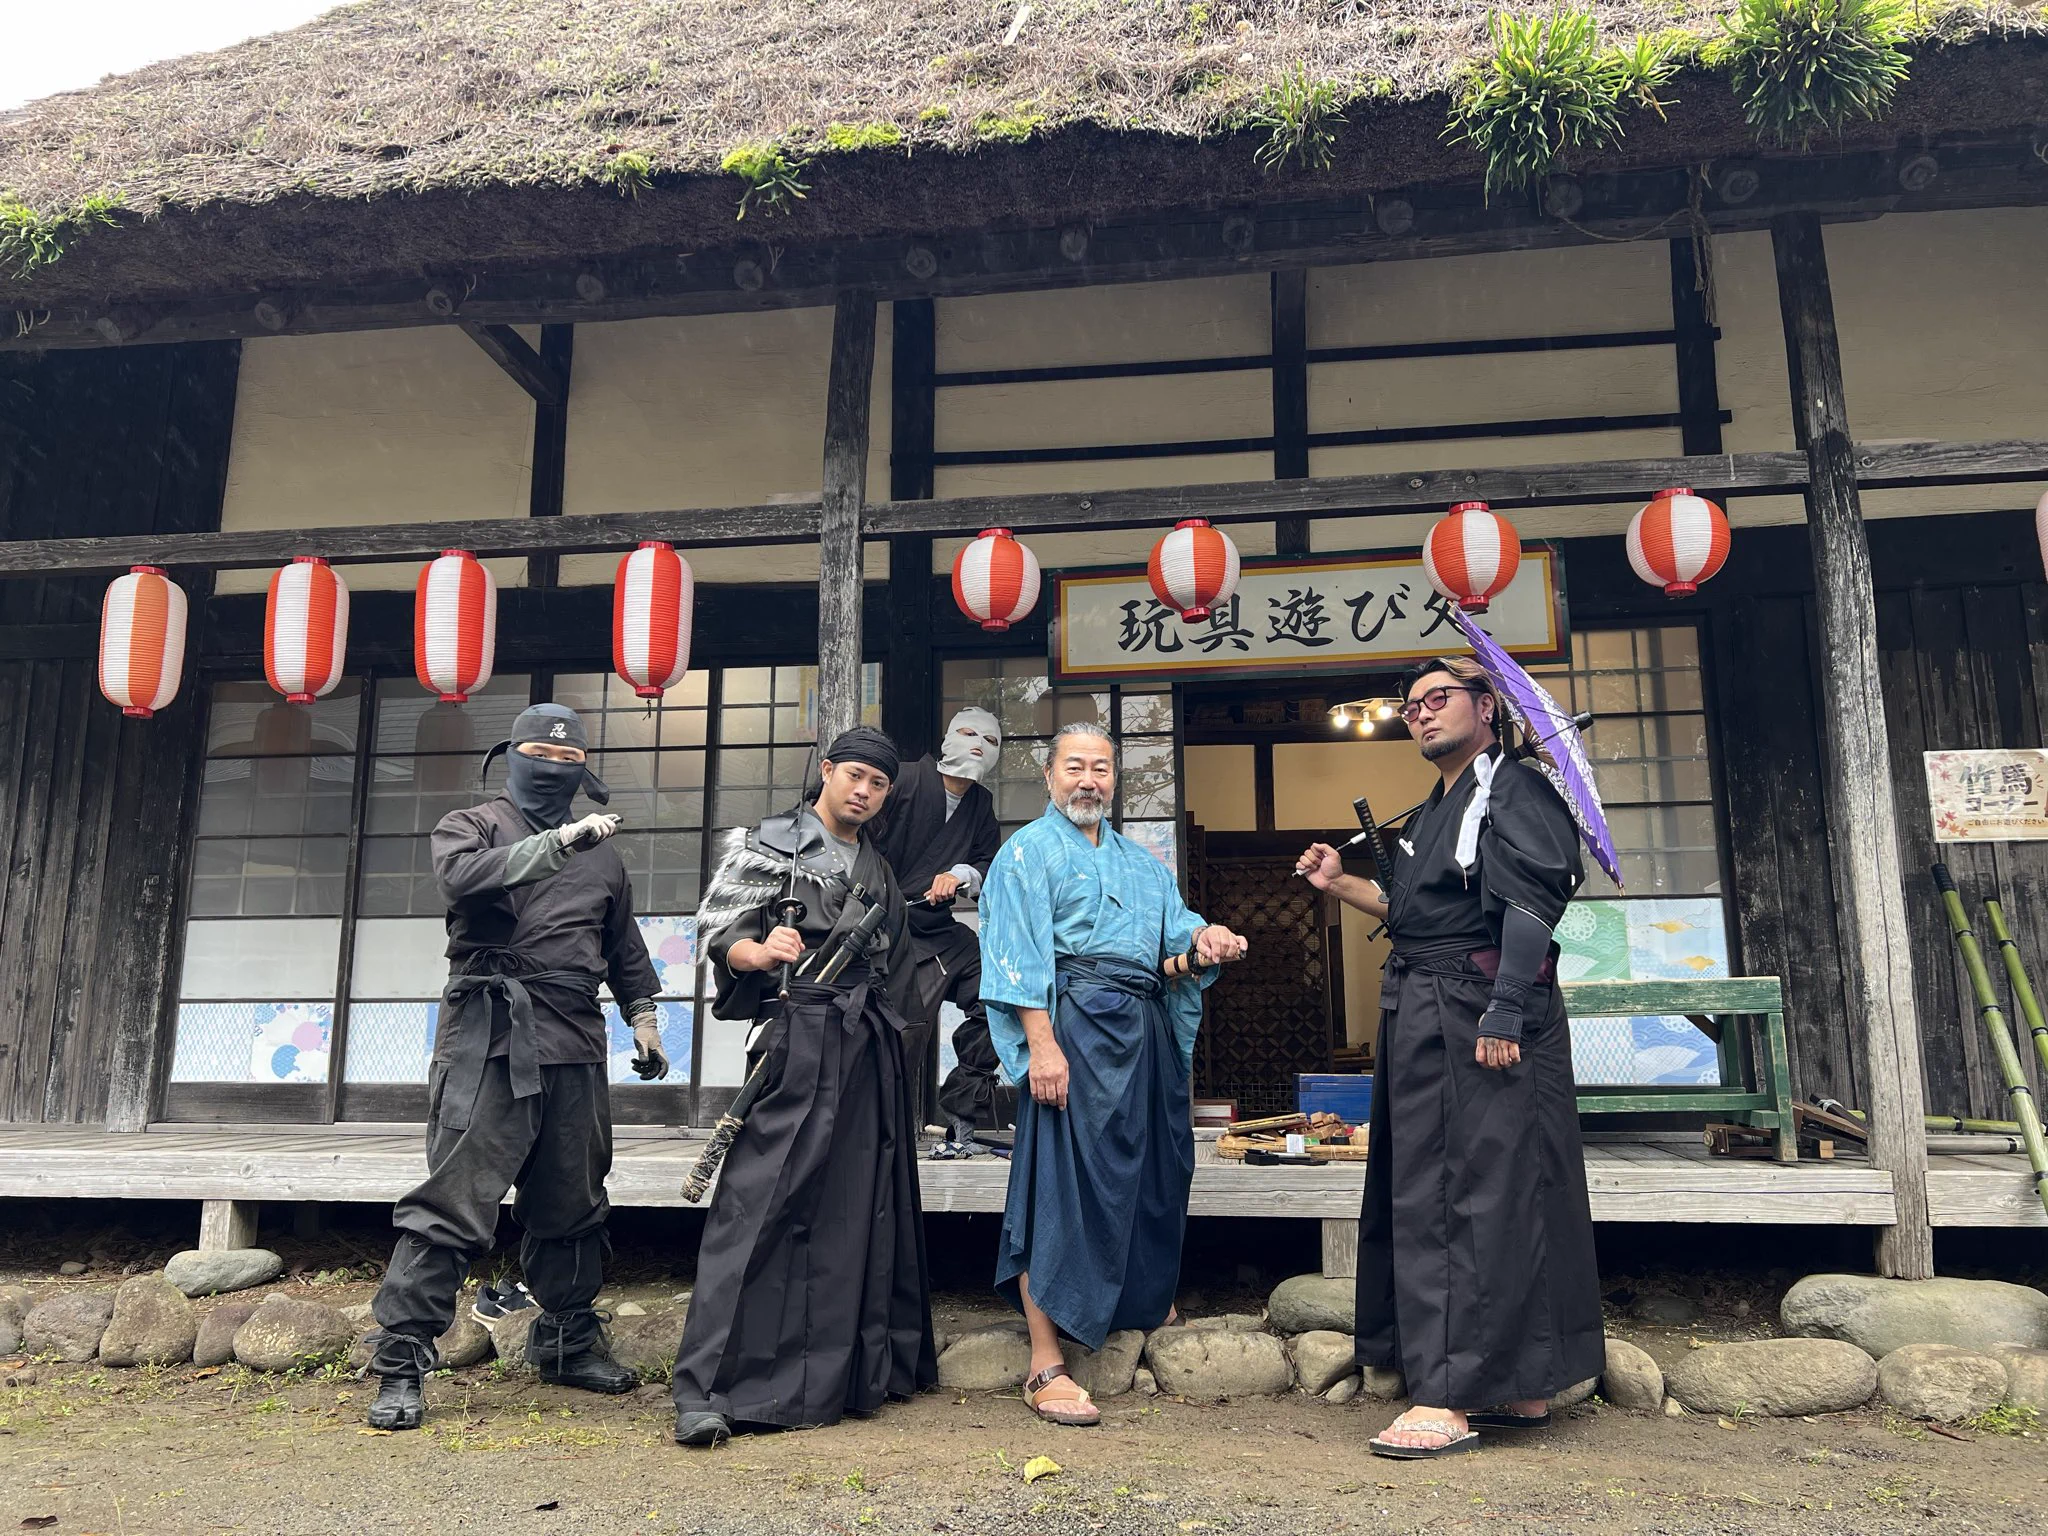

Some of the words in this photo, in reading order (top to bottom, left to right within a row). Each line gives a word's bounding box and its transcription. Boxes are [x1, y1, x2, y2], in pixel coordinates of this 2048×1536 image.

[549, 722, 567, 739] 忍
[1960, 763, 2032, 795] 竹馬
[1965, 796, 2039, 812] コーナー
[1967, 818, 2045, 826] ご自由にお遊びください
